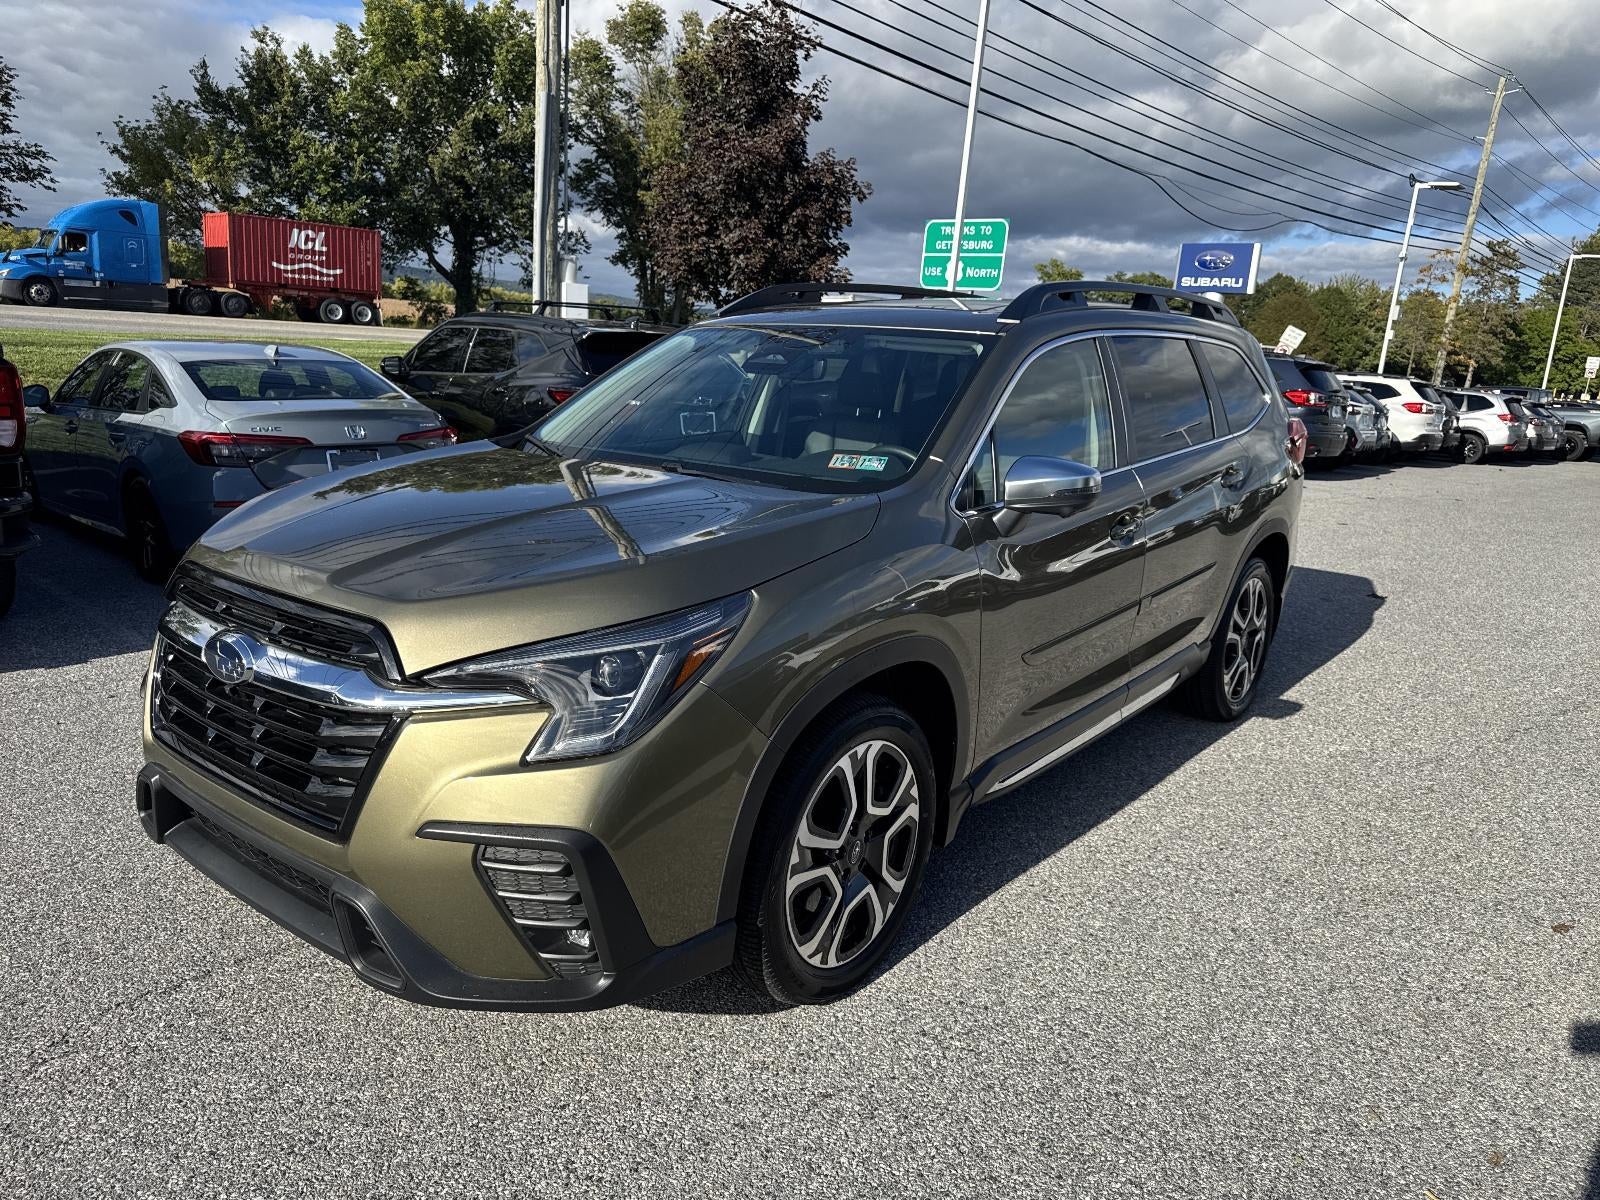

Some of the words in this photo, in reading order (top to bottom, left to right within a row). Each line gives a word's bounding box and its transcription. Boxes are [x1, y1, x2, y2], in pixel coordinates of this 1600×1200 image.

[941, 226, 976, 235] TRUKS
[980, 225, 993, 235] TO
[288, 228, 328, 252] ICL
[935, 240, 994, 250] GETSBURG
[288, 253, 327, 262] GROUP
[924, 267, 943, 276] USE
[965, 266, 999, 278] NORTH
[1180, 276, 1244, 288] SUBARU
[250, 425, 283, 433] CIVIC
